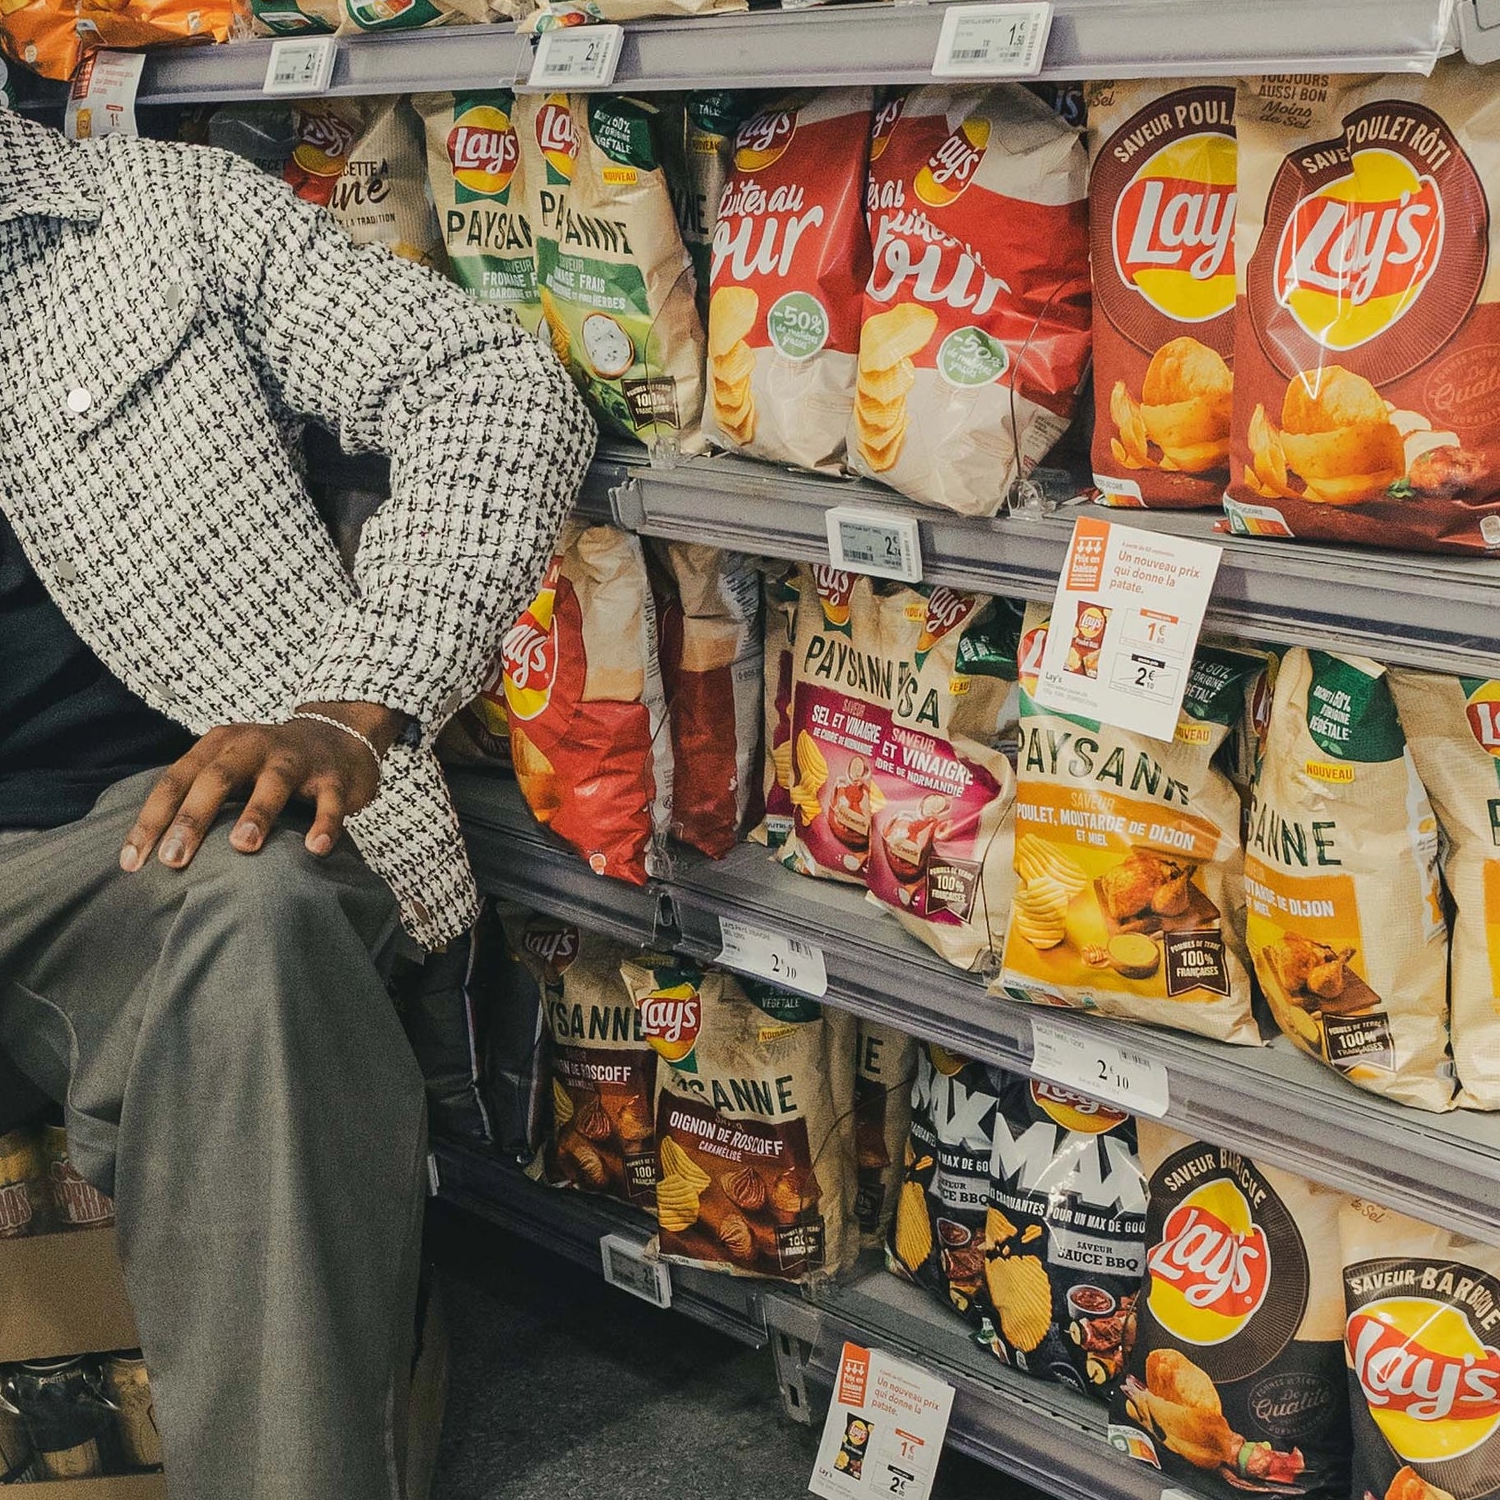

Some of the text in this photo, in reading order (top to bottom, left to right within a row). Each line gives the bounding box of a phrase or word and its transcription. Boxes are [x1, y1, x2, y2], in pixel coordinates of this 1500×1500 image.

[454, 123, 518, 174] Lay's
[1115, 114, 1171, 161] SAVEUR
[1348, 117, 1450, 172] POULET RÔTI
[768, 184, 803, 211] au
[1286, 199, 1435, 300] Lay's
[1114, 566, 1175, 587] qui donne la
[1118, 551, 1200, 579] Un nouveau prix
[1109, 579, 1144, 594] patate.
[812, 706, 829, 725] SEL
[903, 747, 974, 784] VINAIGRE
[908, 768, 964, 797] NORMANDIE
[1305, 763, 1353, 780] NOUVEAU
[1017, 803, 1195, 851] POULET, MOUTARDE DE DIJON
[1182, 950, 1214, 967] 100%
[641, 1003, 697, 1039] Lay's
[670, 1111, 783, 1156] OIGNON DE ROSCOFF
[991, 1112, 1150, 1218] MAX
[1058, 1250, 1139, 1271] SAUCE BBQ
[1149, 1210, 1253, 1307] Lay's
[1352, 1269, 1415, 1293] SAVEUR
[1349, 1319, 1500, 1420] Lay's
